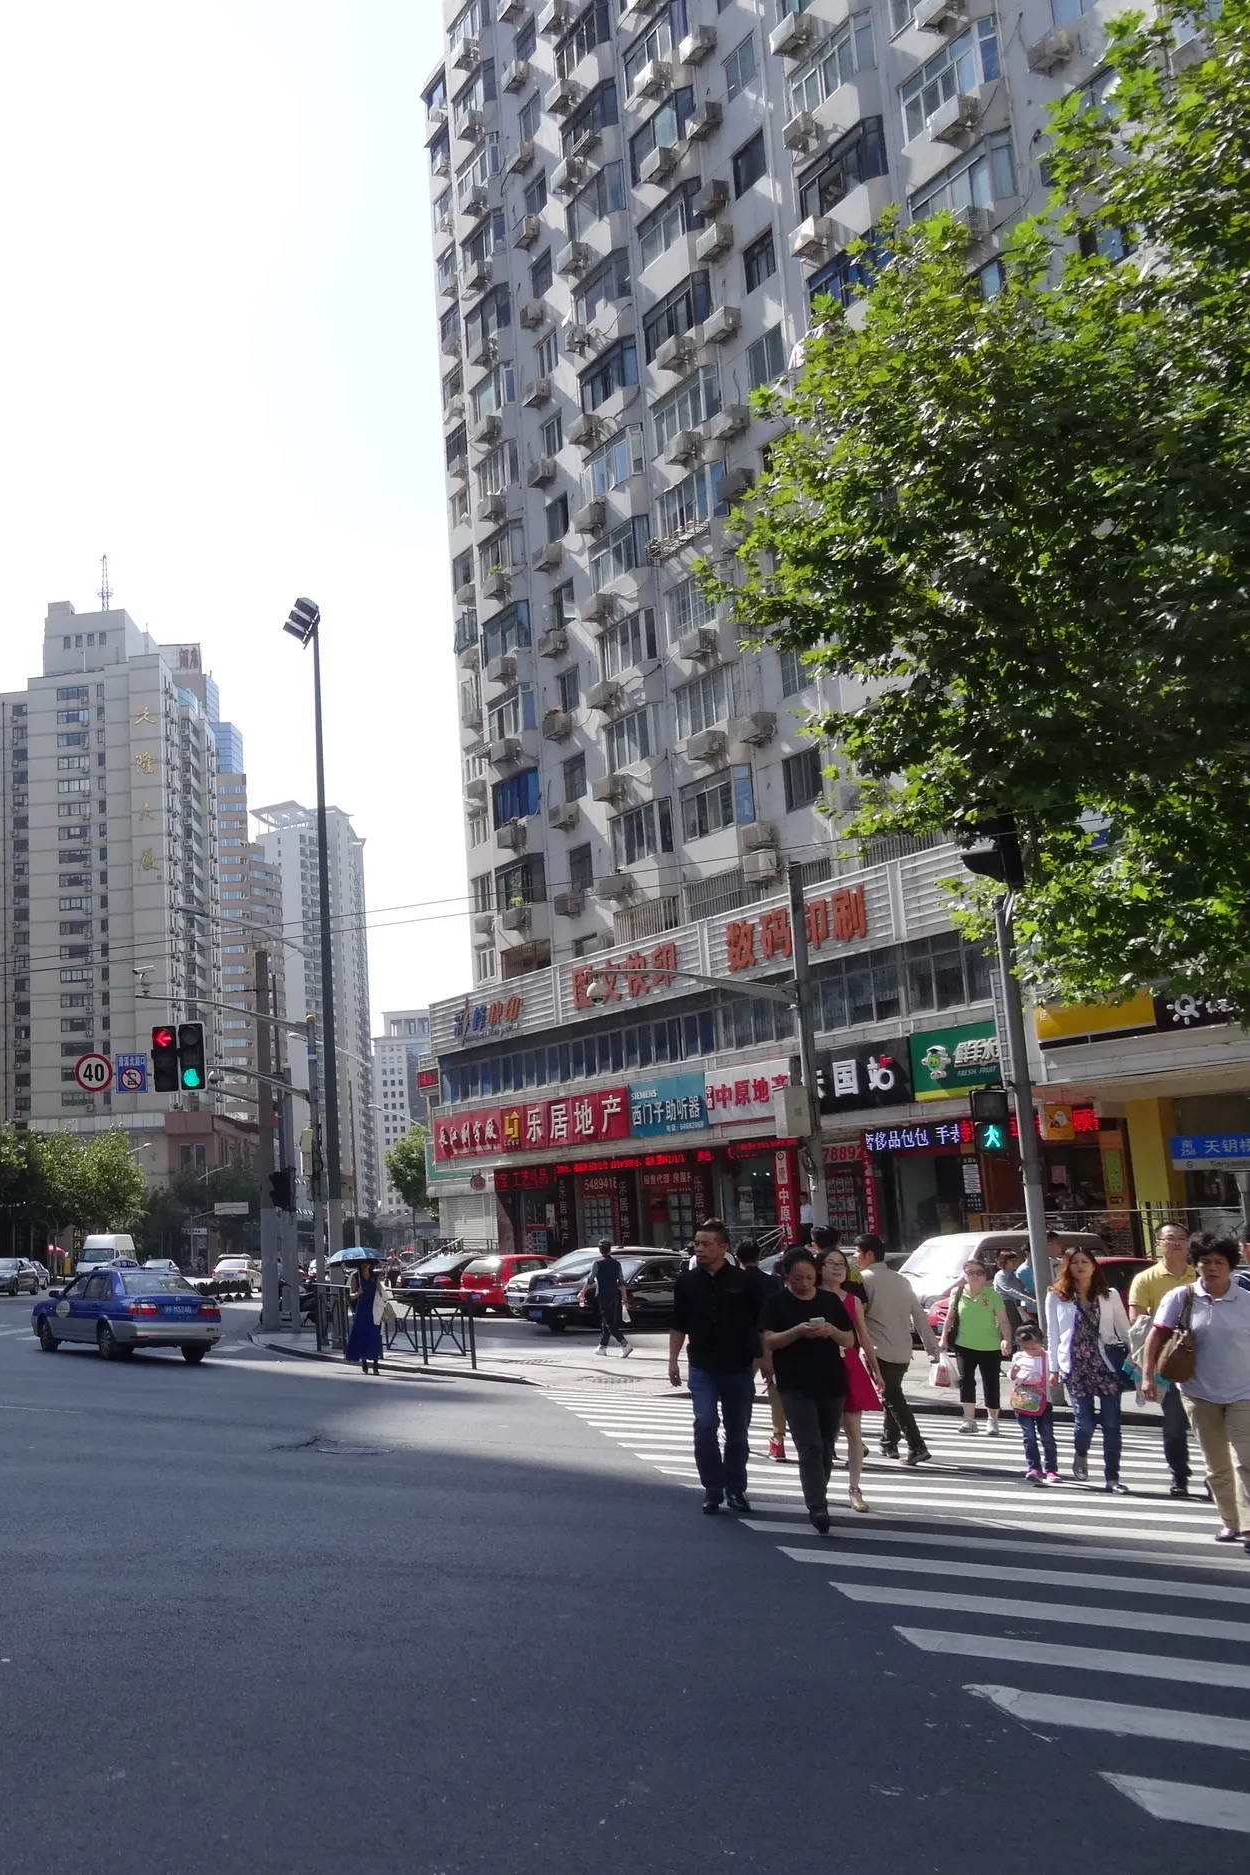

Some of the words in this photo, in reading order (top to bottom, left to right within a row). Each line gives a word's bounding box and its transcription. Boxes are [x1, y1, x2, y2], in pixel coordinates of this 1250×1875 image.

[83, 1063, 105, 1082] 40
[630, 1089, 657, 1101] SIEMENS
[631, 1095, 701, 1126] 西门子助听器
[526, 1094, 623, 1144] 乐居地产
[618, 1181, 631, 1245] 乐居地产
